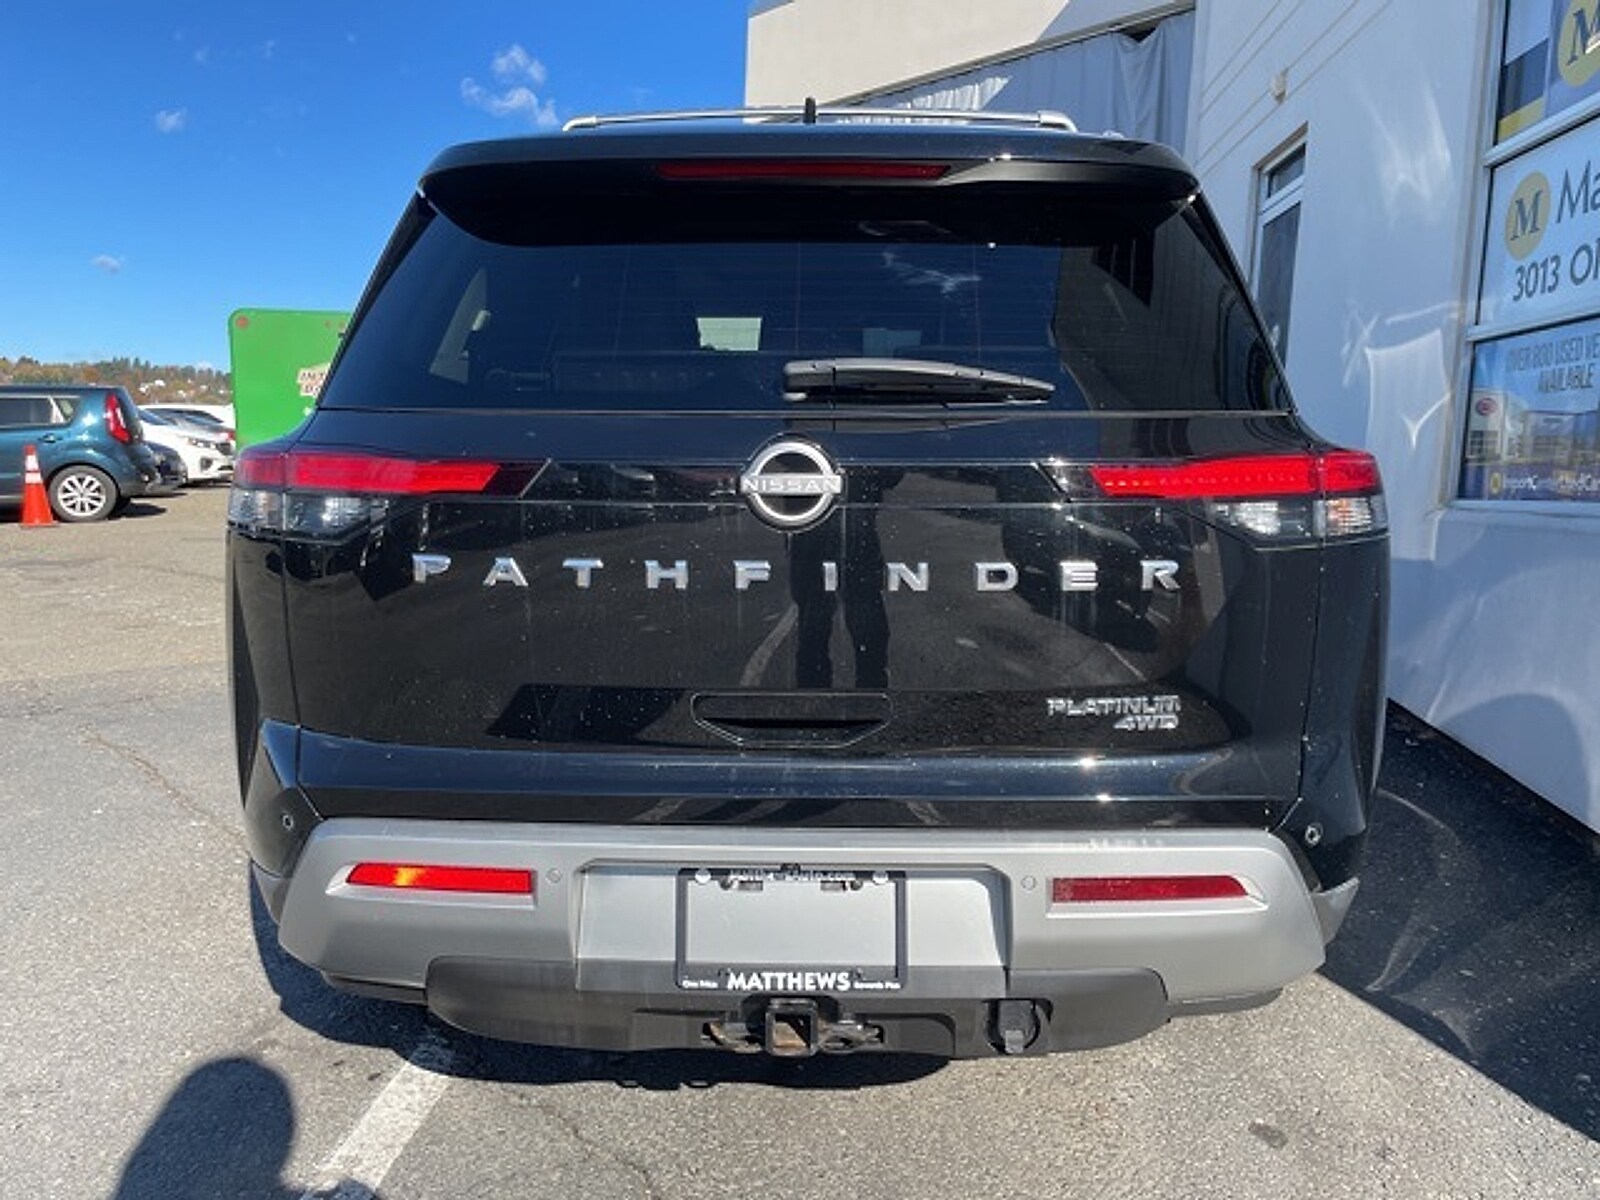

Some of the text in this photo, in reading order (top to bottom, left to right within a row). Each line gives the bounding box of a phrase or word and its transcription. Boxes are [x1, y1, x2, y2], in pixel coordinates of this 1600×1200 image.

[1510, 190, 1543, 241] M
[1512, 254, 1561, 302] 3013
[742, 477, 840, 494] NISSAN
[412, 554, 1181, 592] PATHFINDER
[1047, 695, 1181, 716] PLATINUM
[1113, 714, 1179, 731] 4WD
[727, 971, 850, 991] MATTHEWS
